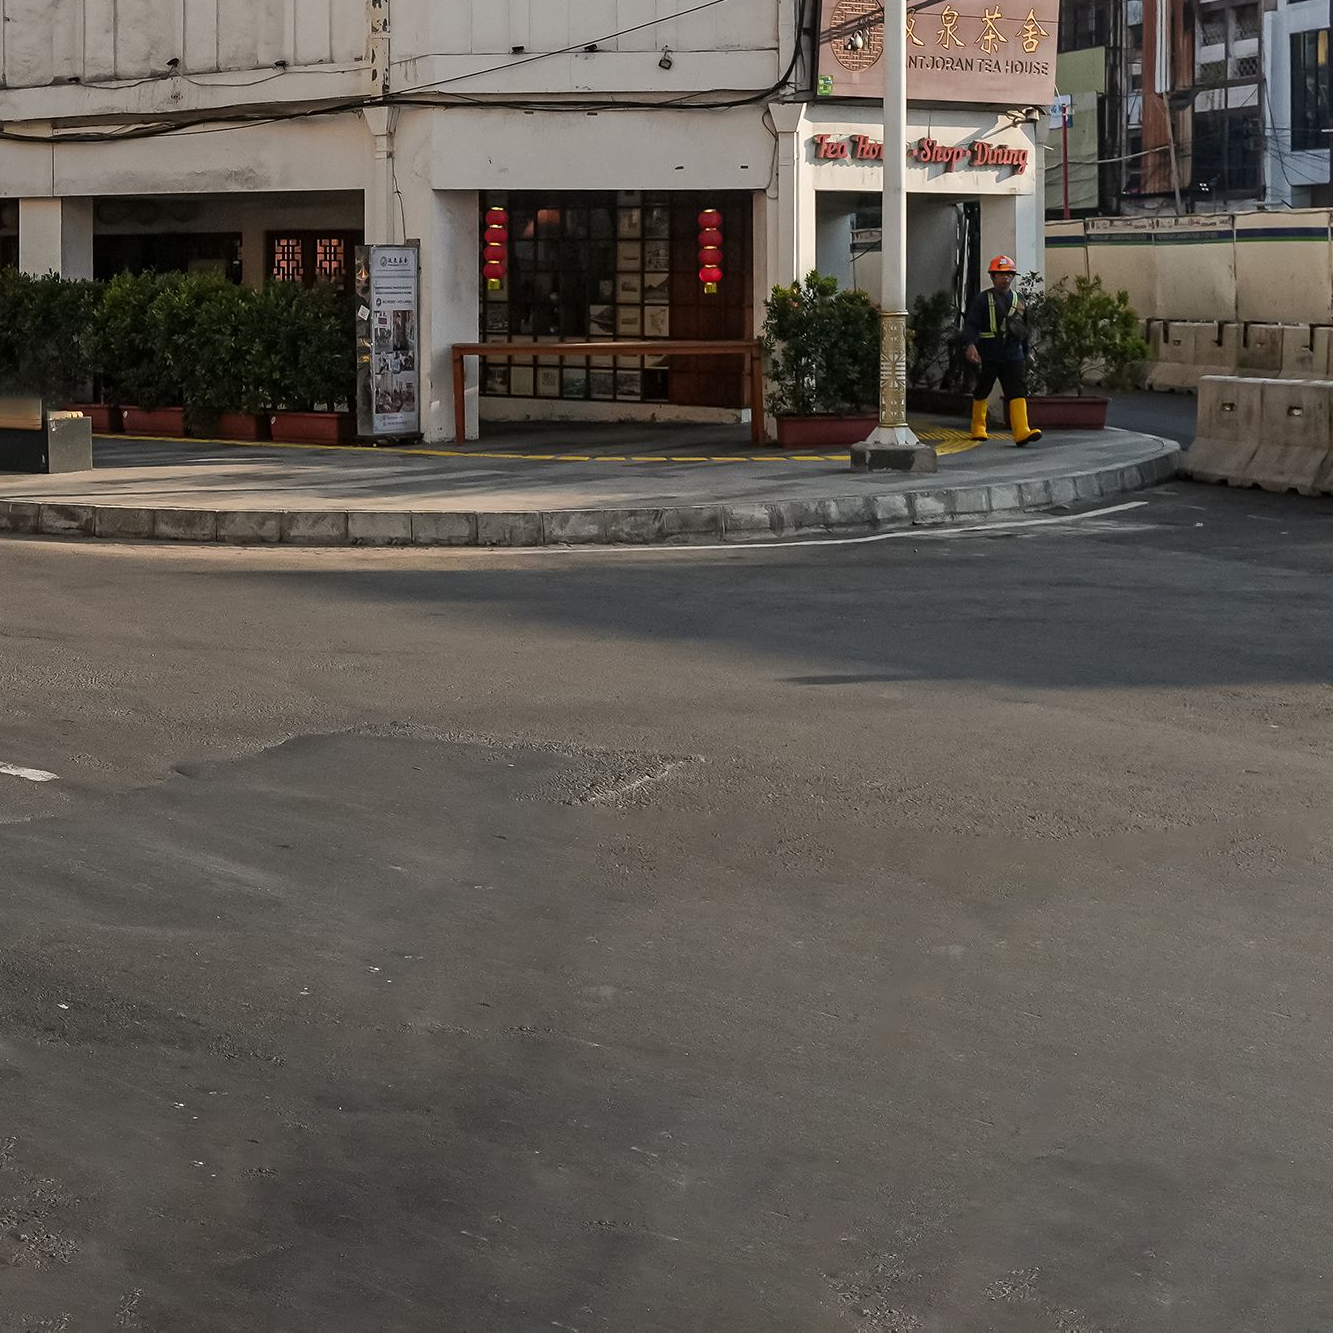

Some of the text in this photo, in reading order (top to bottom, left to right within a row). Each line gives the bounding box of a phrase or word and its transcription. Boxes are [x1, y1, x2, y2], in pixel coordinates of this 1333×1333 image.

[906, 55, 1049, 76] NTJORAN TEA HOUSE
[813, 134, 848, 159] Tea
[919, 137, 964, 172] Shop
[971, 141, 1029, 175] Dining
